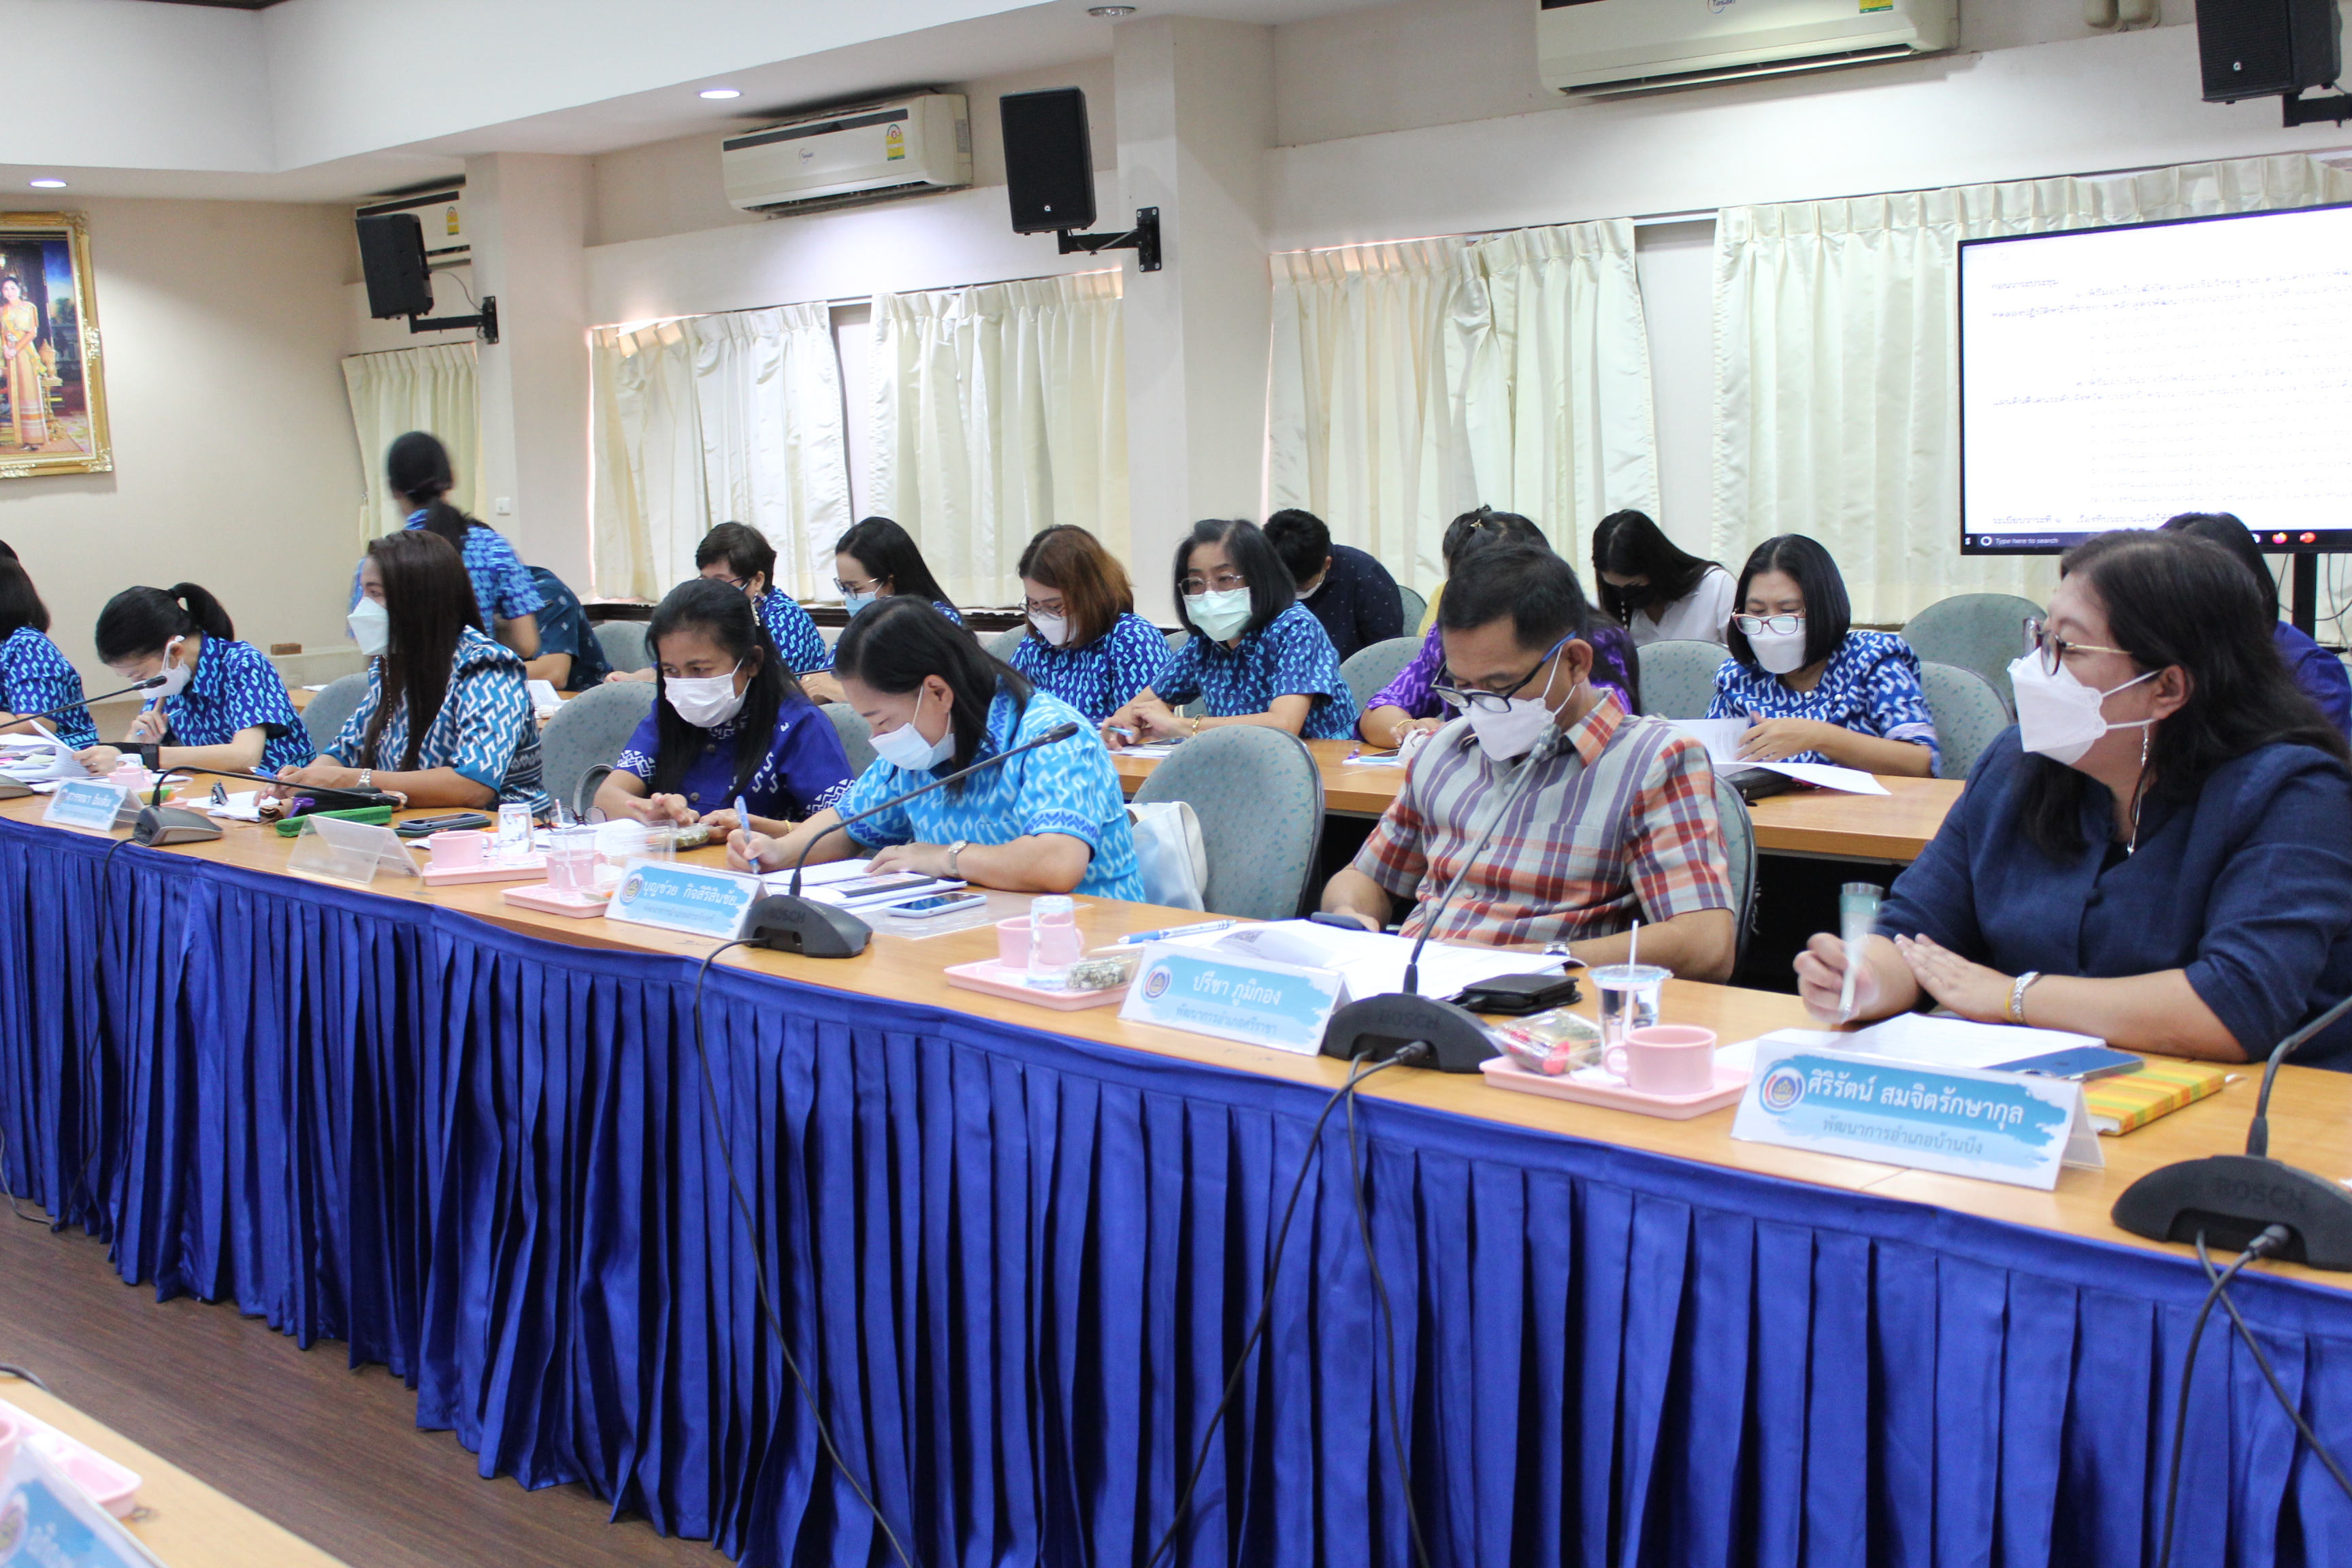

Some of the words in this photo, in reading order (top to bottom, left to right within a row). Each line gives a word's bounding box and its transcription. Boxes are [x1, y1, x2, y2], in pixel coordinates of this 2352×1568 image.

[643, 879, 679, 897] บุญช่วย
[1193, 970, 1229, 996] ปรีชา
[1231, 978, 1282, 1007] ภูมิกอง
[1808, 1068, 1877, 1102] ศิริรัตน์
[1880, 1083, 2025, 1131] สมจิตรักษากุล
[1823, 1115, 1983, 1156] พัฒนาการอำเภอบ้านบึง
